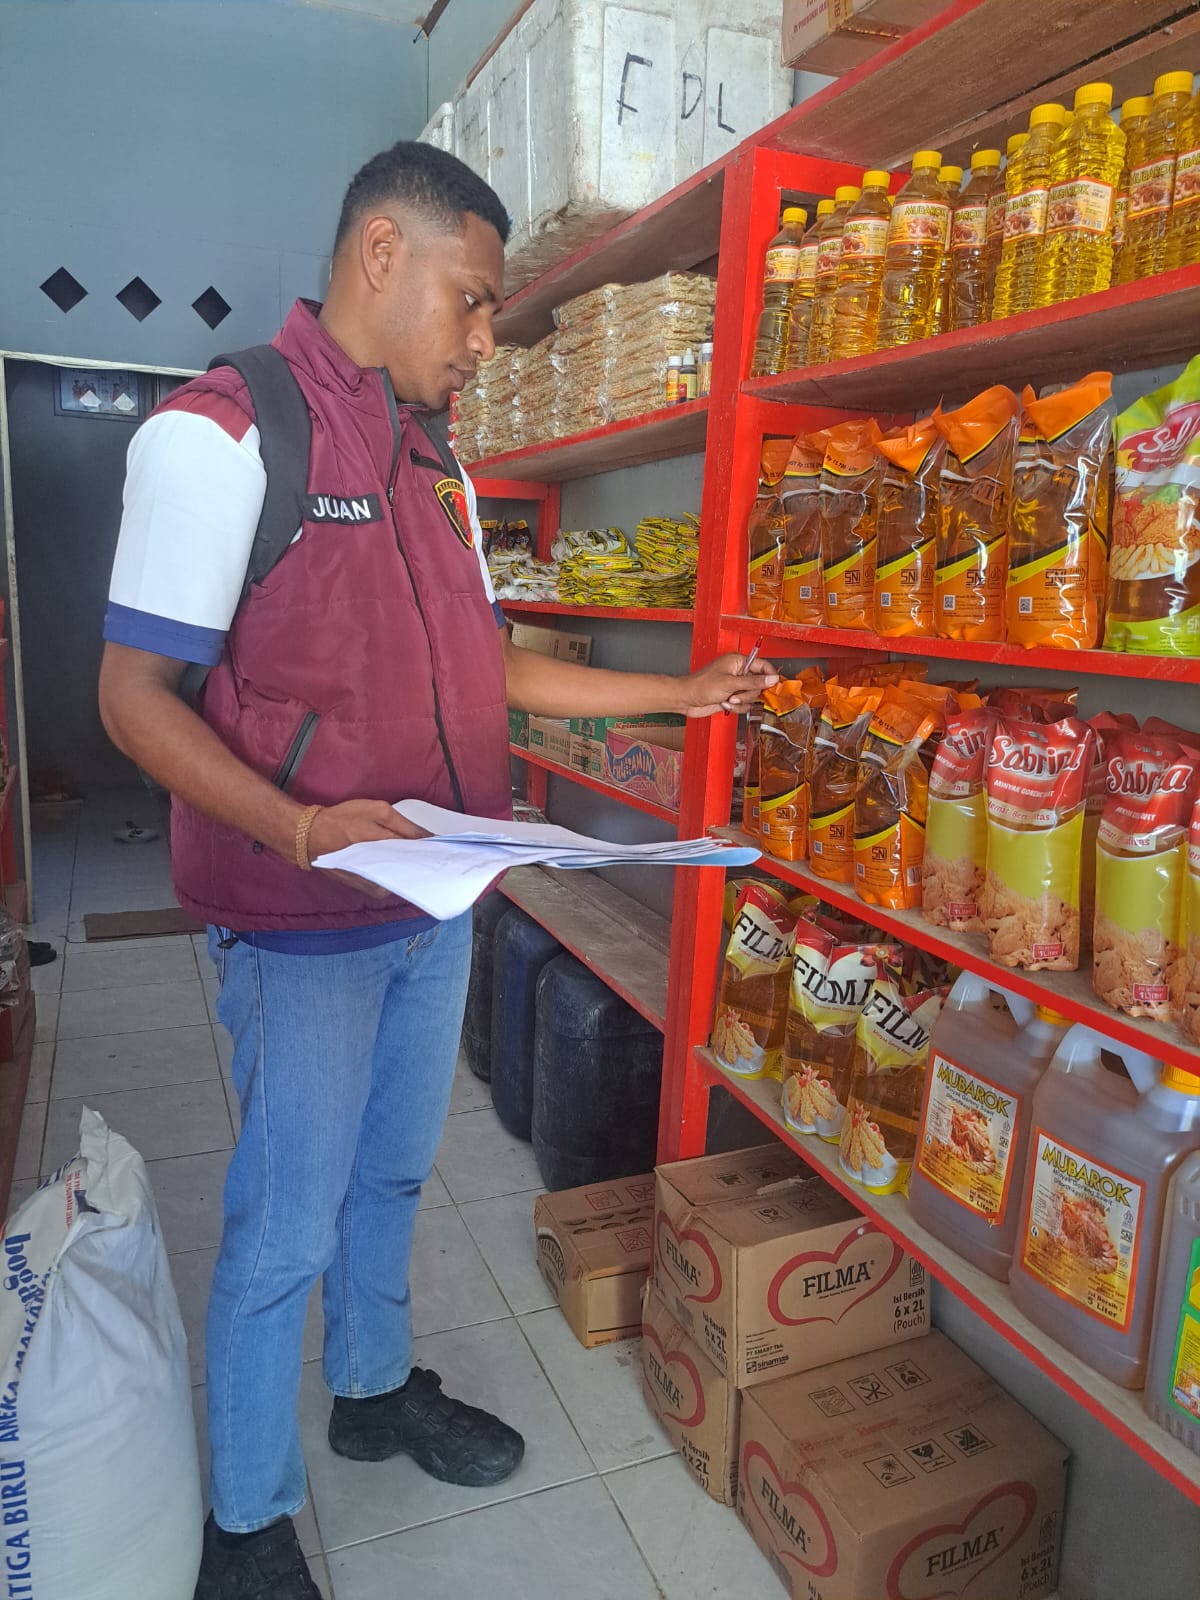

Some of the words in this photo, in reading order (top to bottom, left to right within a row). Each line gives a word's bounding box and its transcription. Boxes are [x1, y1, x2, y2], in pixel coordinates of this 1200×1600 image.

[312, 496, 372, 521] JUAN
[845, 569, 860, 585] SNI
[829, 824, 845, 839] SNI
[871, 845, 888, 861] SNI
[861, 989, 930, 1051] FILM
[937, 1062, 1011, 1118] MUBAROK
[1042, 1143, 1133, 1207] MUBAROK
[665, 1237, 700, 1289] FILMA
[802, 1261, 872, 1299] FILMA
[893, 1294, 902, 1305] Isi
[903, 1287, 925, 1301] Bersih
[1087, 1297, 1094, 1305] 5
[1096, 1303, 1118, 1319] Liter
[894, 1305, 901, 1319] 6
[903, 1305, 910, 1316] x
[912, 1299, 925, 1313] 2L
[893, 1311, 926, 1334] (Pouch)
[716, 1335, 727, 1354] 2L
[757, 1355, 789, 1369] sinarmas
[649, 1351, 681, 1410] FILMA
[695, 1457, 710, 1476] 2L
[0, 1459, 29, 1526] BIRU
[761, 1476, 808, 1555] FILMA
[6, 1528, 33, 1600] TIGA
[925, 1528, 1000, 1578] FILMA
